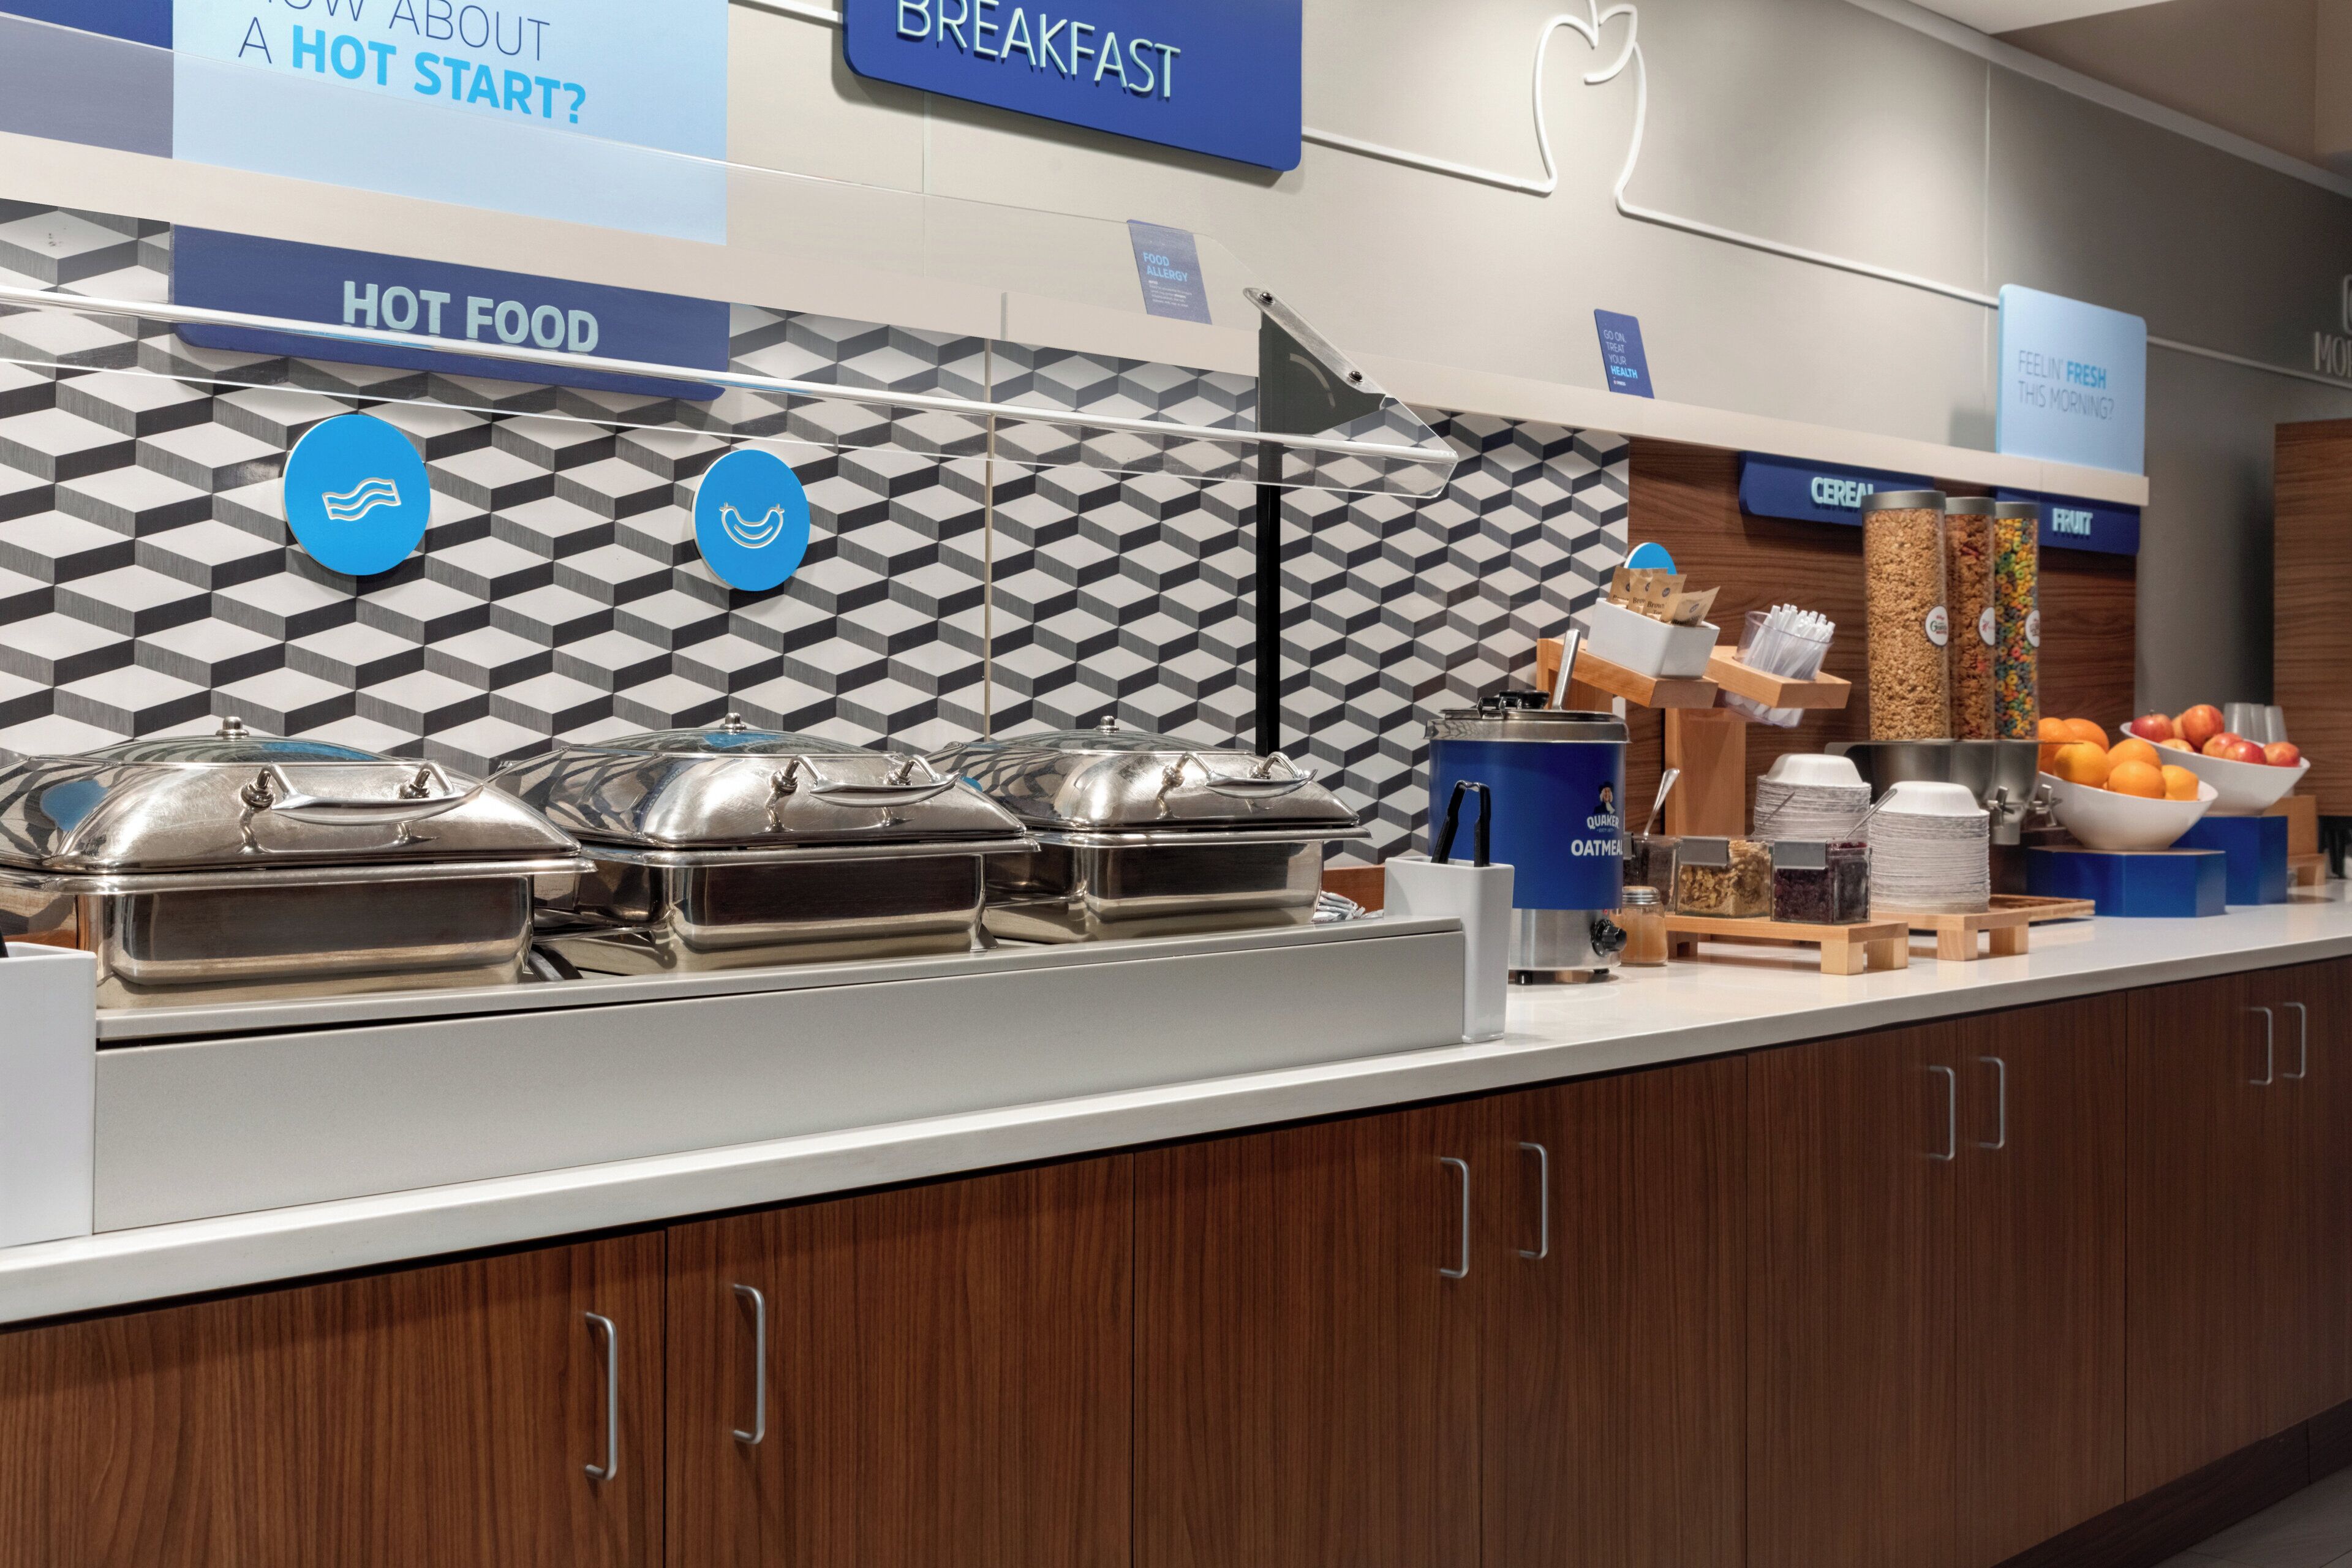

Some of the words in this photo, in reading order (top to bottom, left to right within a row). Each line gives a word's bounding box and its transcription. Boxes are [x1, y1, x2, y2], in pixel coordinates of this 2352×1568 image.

[389, 0, 550, 61] ABOUT
[896, 0, 1181, 98] BREAKFAST
[238, 17, 273, 64] A
[292, 24, 397, 86] HOT
[413, 51, 586, 124] START?
[1143, 252, 1169, 266] FOOD
[1147, 265, 1188, 282] ALLERGY
[343, 281, 451, 334] HOT
[466, 296, 599, 352] FOOD
[1604, 330, 1614, 340] GO
[1605, 341, 1624, 353] TREAT
[1608, 354, 1627, 365] YOUR
[2314, 331, 2352, 378] MO
[1610, 365, 1638, 379] HEALTH
[2018, 350, 2064, 380] FEELIN'
[2067, 361, 2106, 389] FRESH
[2018, 380, 2046, 407] THIS
[2051, 387, 2114, 420] MORNING?
[2052, 508, 2094, 535] FRUIT
[1586, 814, 1619, 829] QUAKER
